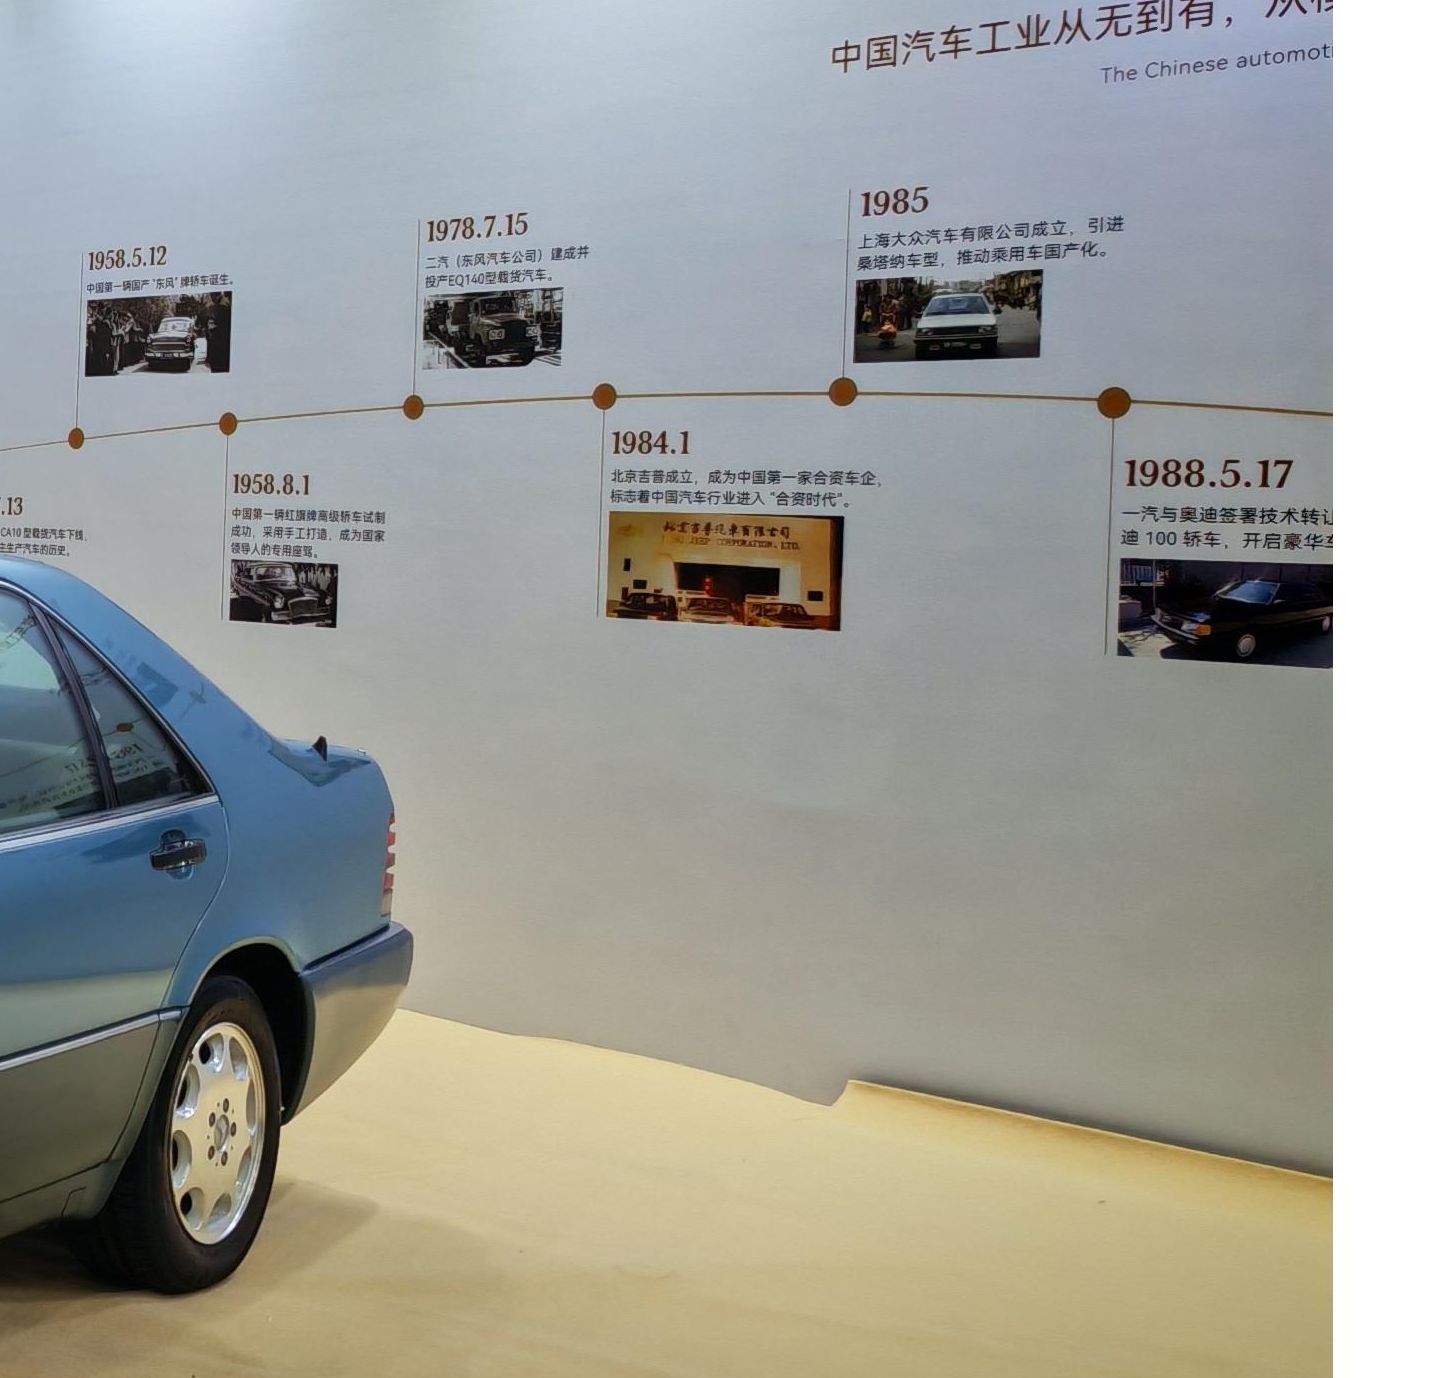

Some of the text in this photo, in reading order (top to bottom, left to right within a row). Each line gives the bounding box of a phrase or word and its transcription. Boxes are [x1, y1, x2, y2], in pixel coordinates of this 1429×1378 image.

[1100, 66, 1139, 84] The
[1144, 56, 1229, 80] Chinese
[860, 186, 931, 218] 1985
[426, 211, 530, 243] 1978.7.15
[857, 215, 1126, 251] 上海大众汽车有限公司成立，引进
[87, 244, 168, 272] 1958.5.12
[611, 430, 691, 456] 1984.1
[232, 472, 310, 496] 1958.8.1
[1124, 458, 1295, 490] 1988.5.17
[1120, 529, 1139, 546] 迪
[1145, 531, 1177, 546] 100
